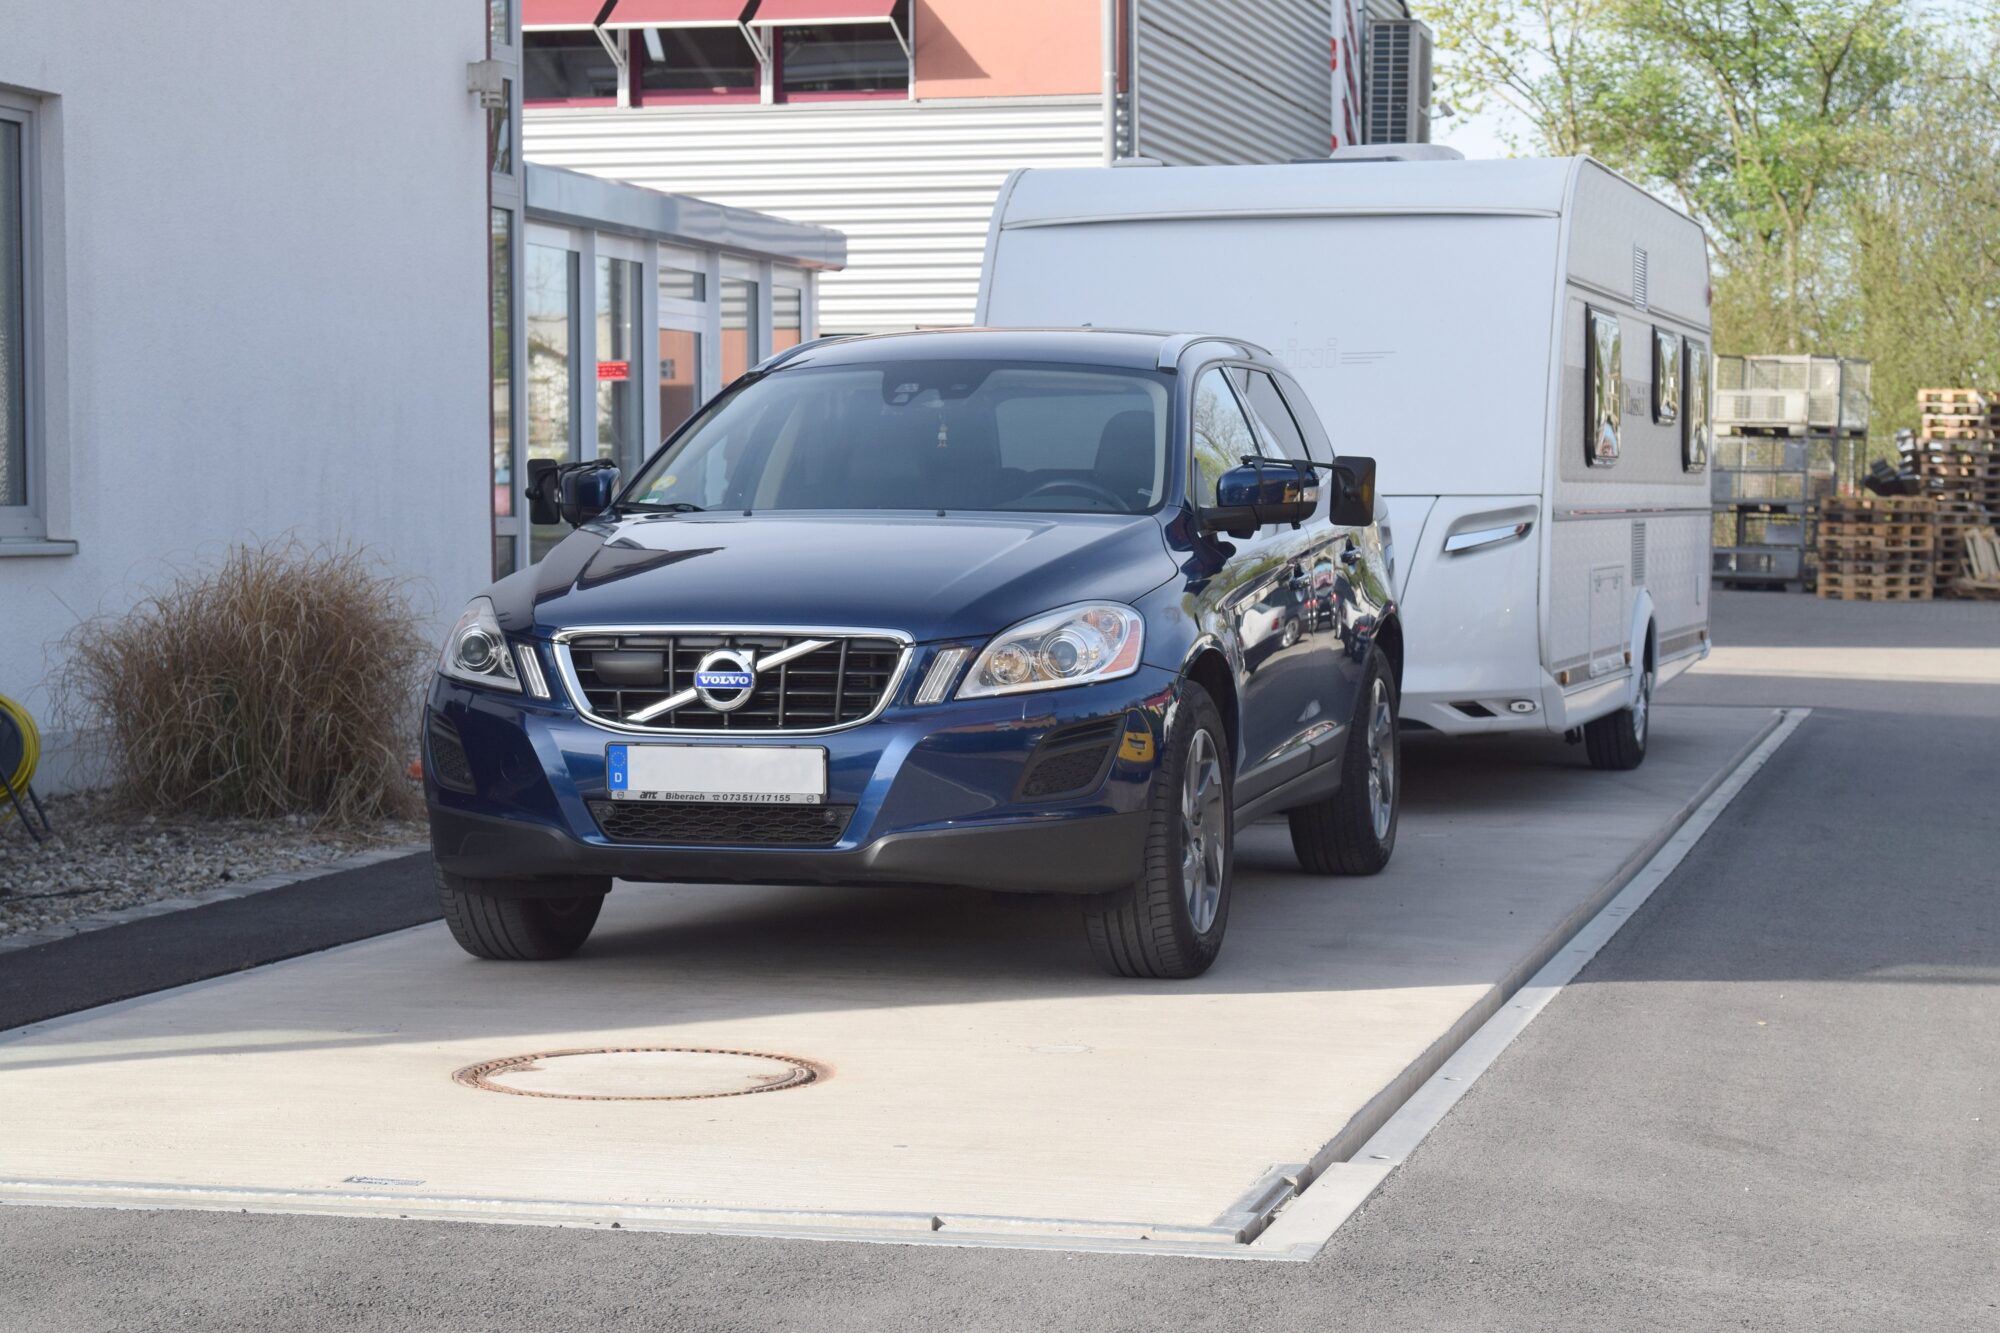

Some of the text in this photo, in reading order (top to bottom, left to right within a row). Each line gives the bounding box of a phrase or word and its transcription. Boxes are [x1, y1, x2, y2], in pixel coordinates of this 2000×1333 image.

[699, 675, 749, 685] VOLVO
[615, 772, 622, 783] D
[665, 792, 705, 800] Biberach
